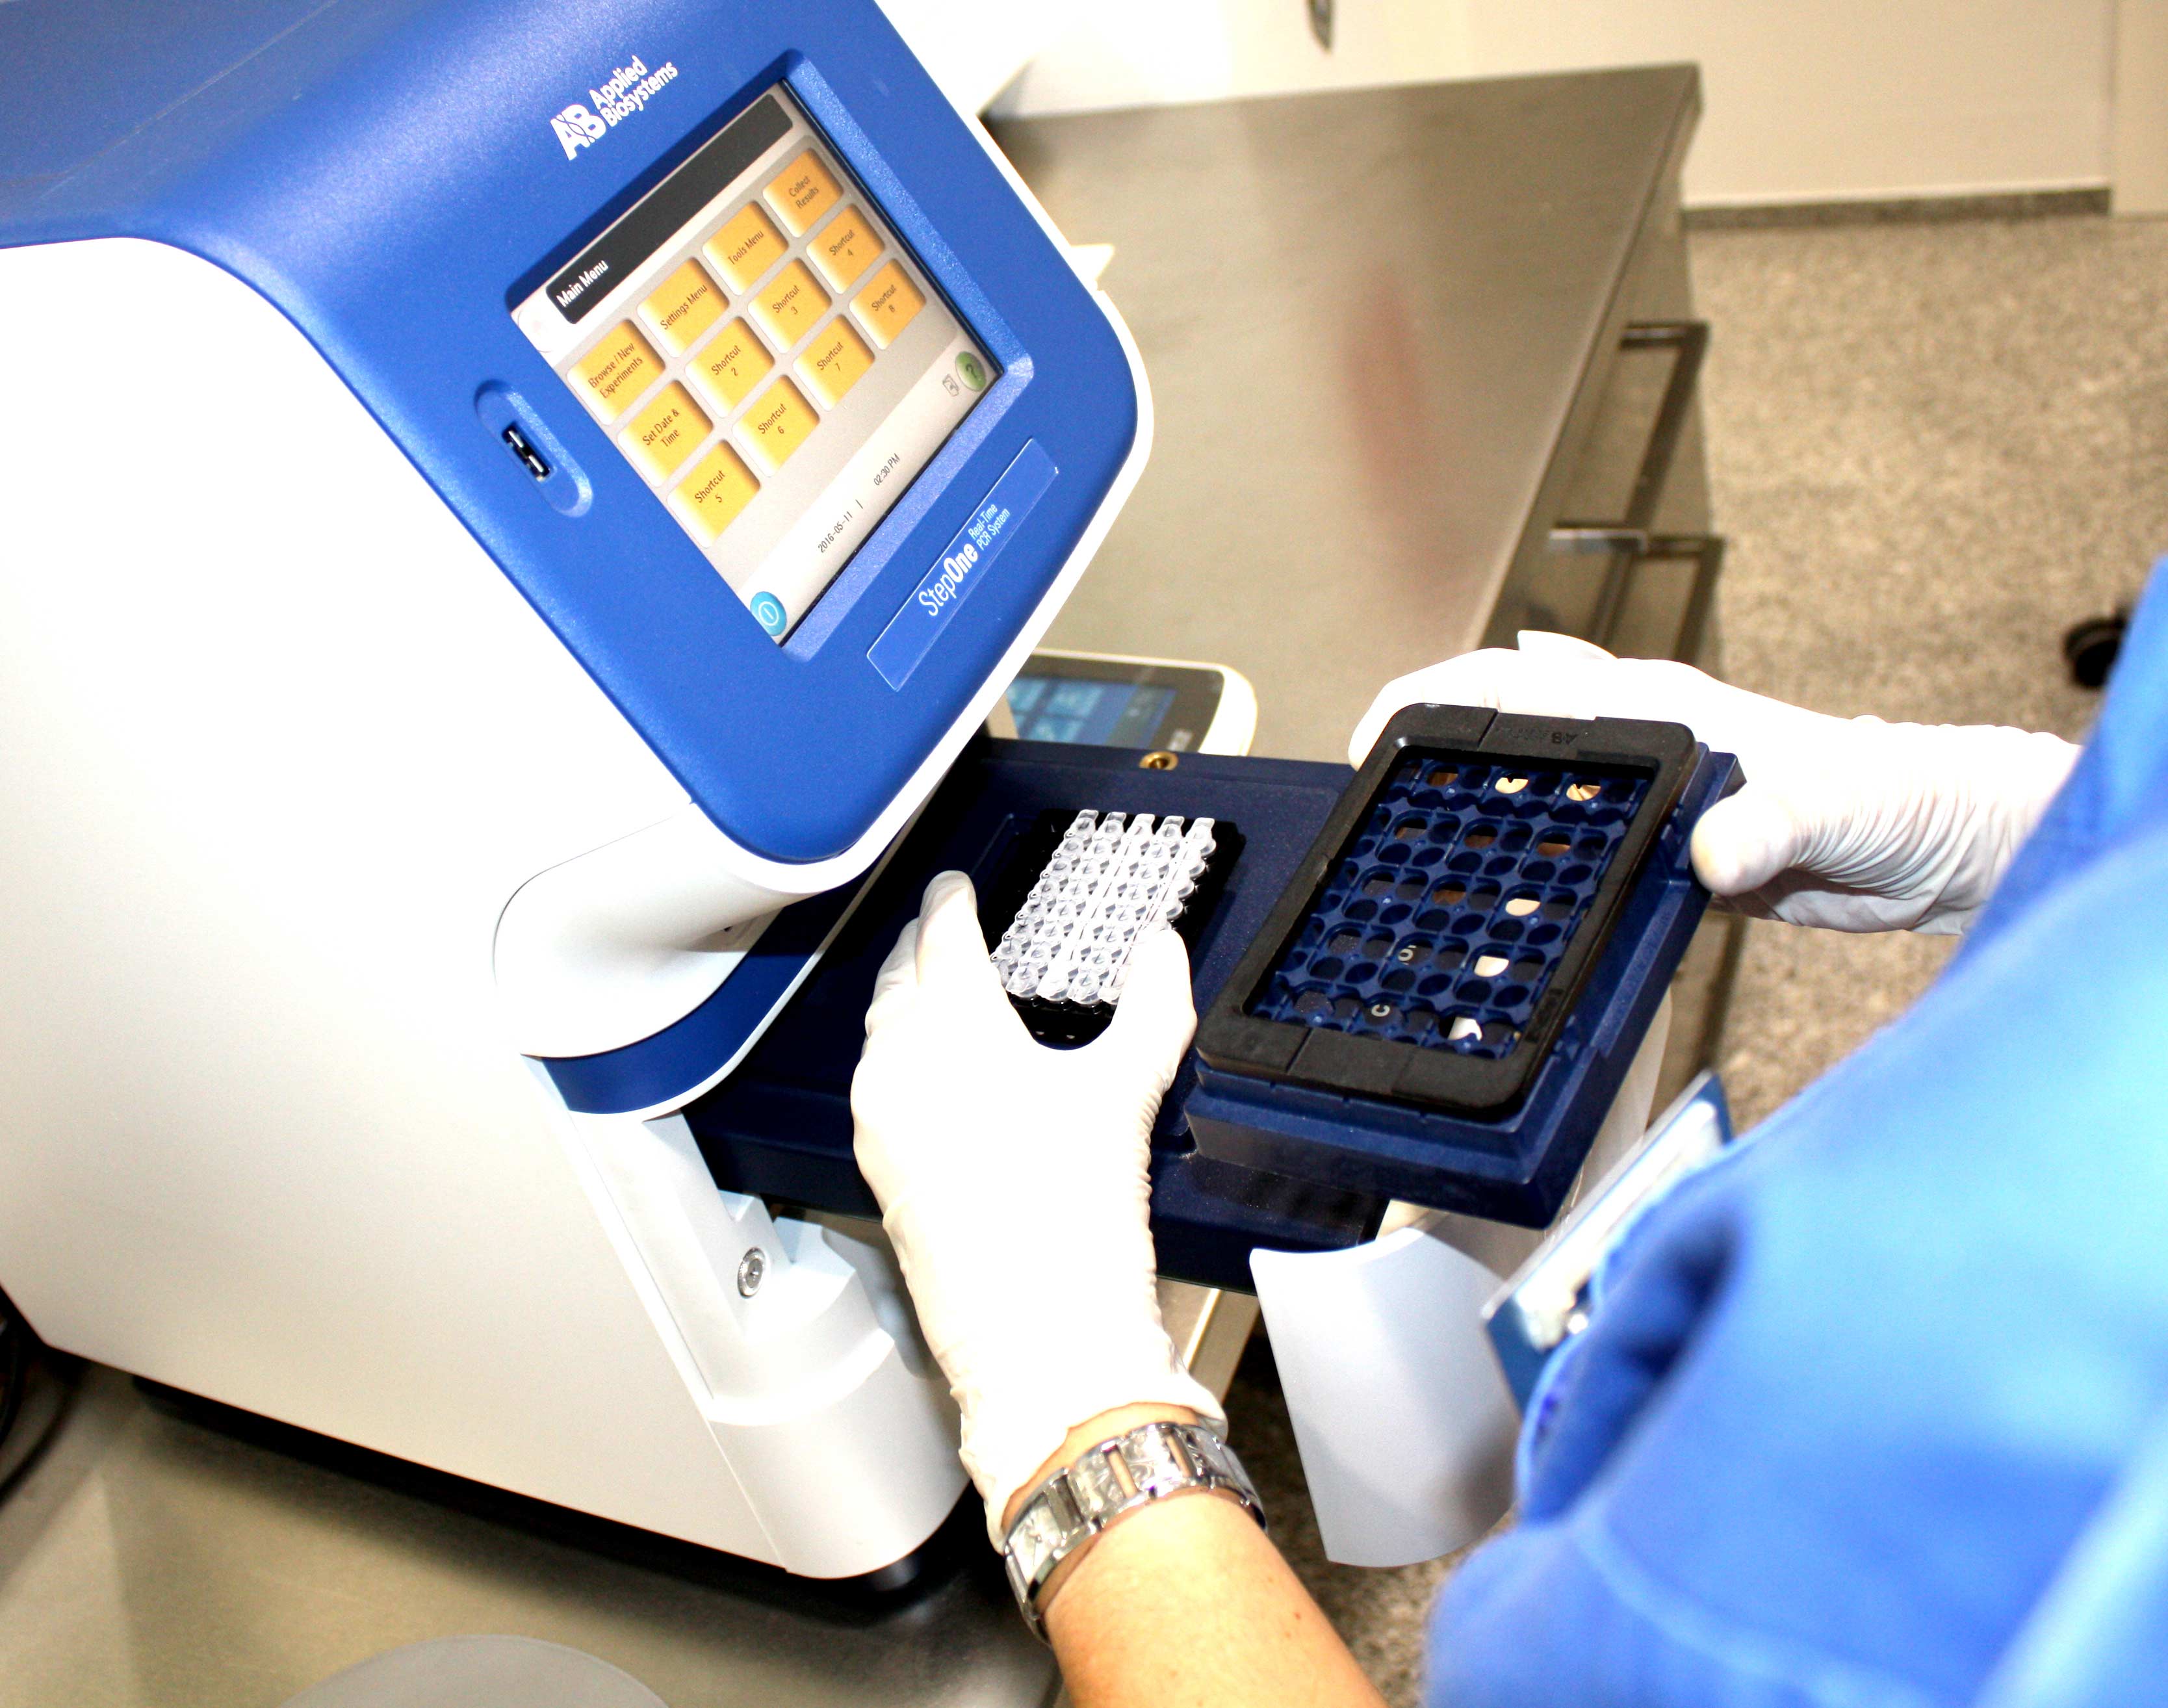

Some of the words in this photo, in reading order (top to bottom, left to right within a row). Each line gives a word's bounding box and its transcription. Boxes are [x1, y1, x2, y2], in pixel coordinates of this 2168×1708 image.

[589, 55, 647, 110] Applied
[600, 62, 678, 127] Biosystems
[550, 104, 606, 161] AB
[788, 175, 811, 198] Collect
[795, 186, 819, 209] Results
[727, 242, 747, 265] Tools
[745, 229, 764, 250] Menu
[829, 229, 855, 256] Shortcut
[556, 284, 584, 307] Main
[579, 260, 608, 288] Menu
[772, 284, 800, 314] Shortcut
[871, 284, 897, 311] Shortcut
[660, 300, 689, 330] Settings
[686, 284, 708, 305] Menu
[793, 306, 799, 315] 3
[588, 360, 616, 388] Browse
[617, 343, 636, 361] New
[711, 344, 741, 375] Shortcut
[731, 367, 739, 376] 2
[816, 341, 844, 370] Shortcut
[835, 363, 841, 371] 7
[599, 357, 643, 399] Experiments
[642, 428, 656, 446] Set
[654, 417, 673, 434] Date
[672, 408, 680, 418] &
[758, 403, 787, 434] Shortcut
[777, 426, 784, 435] 6
[660, 428, 680, 448] Time
[694, 469, 725, 503] Shortcut
[715, 494, 723, 503] 5
[818, 511, 853, 553] 2016-05-11
[873, 465, 890, 485] 02:30
[887, 453, 900, 469] PM
[968, 504, 998, 540] Real-Time
[976, 531, 992, 550] PCR
[987, 508, 1011, 535] System
[918, 543, 978, 616] StepOne
